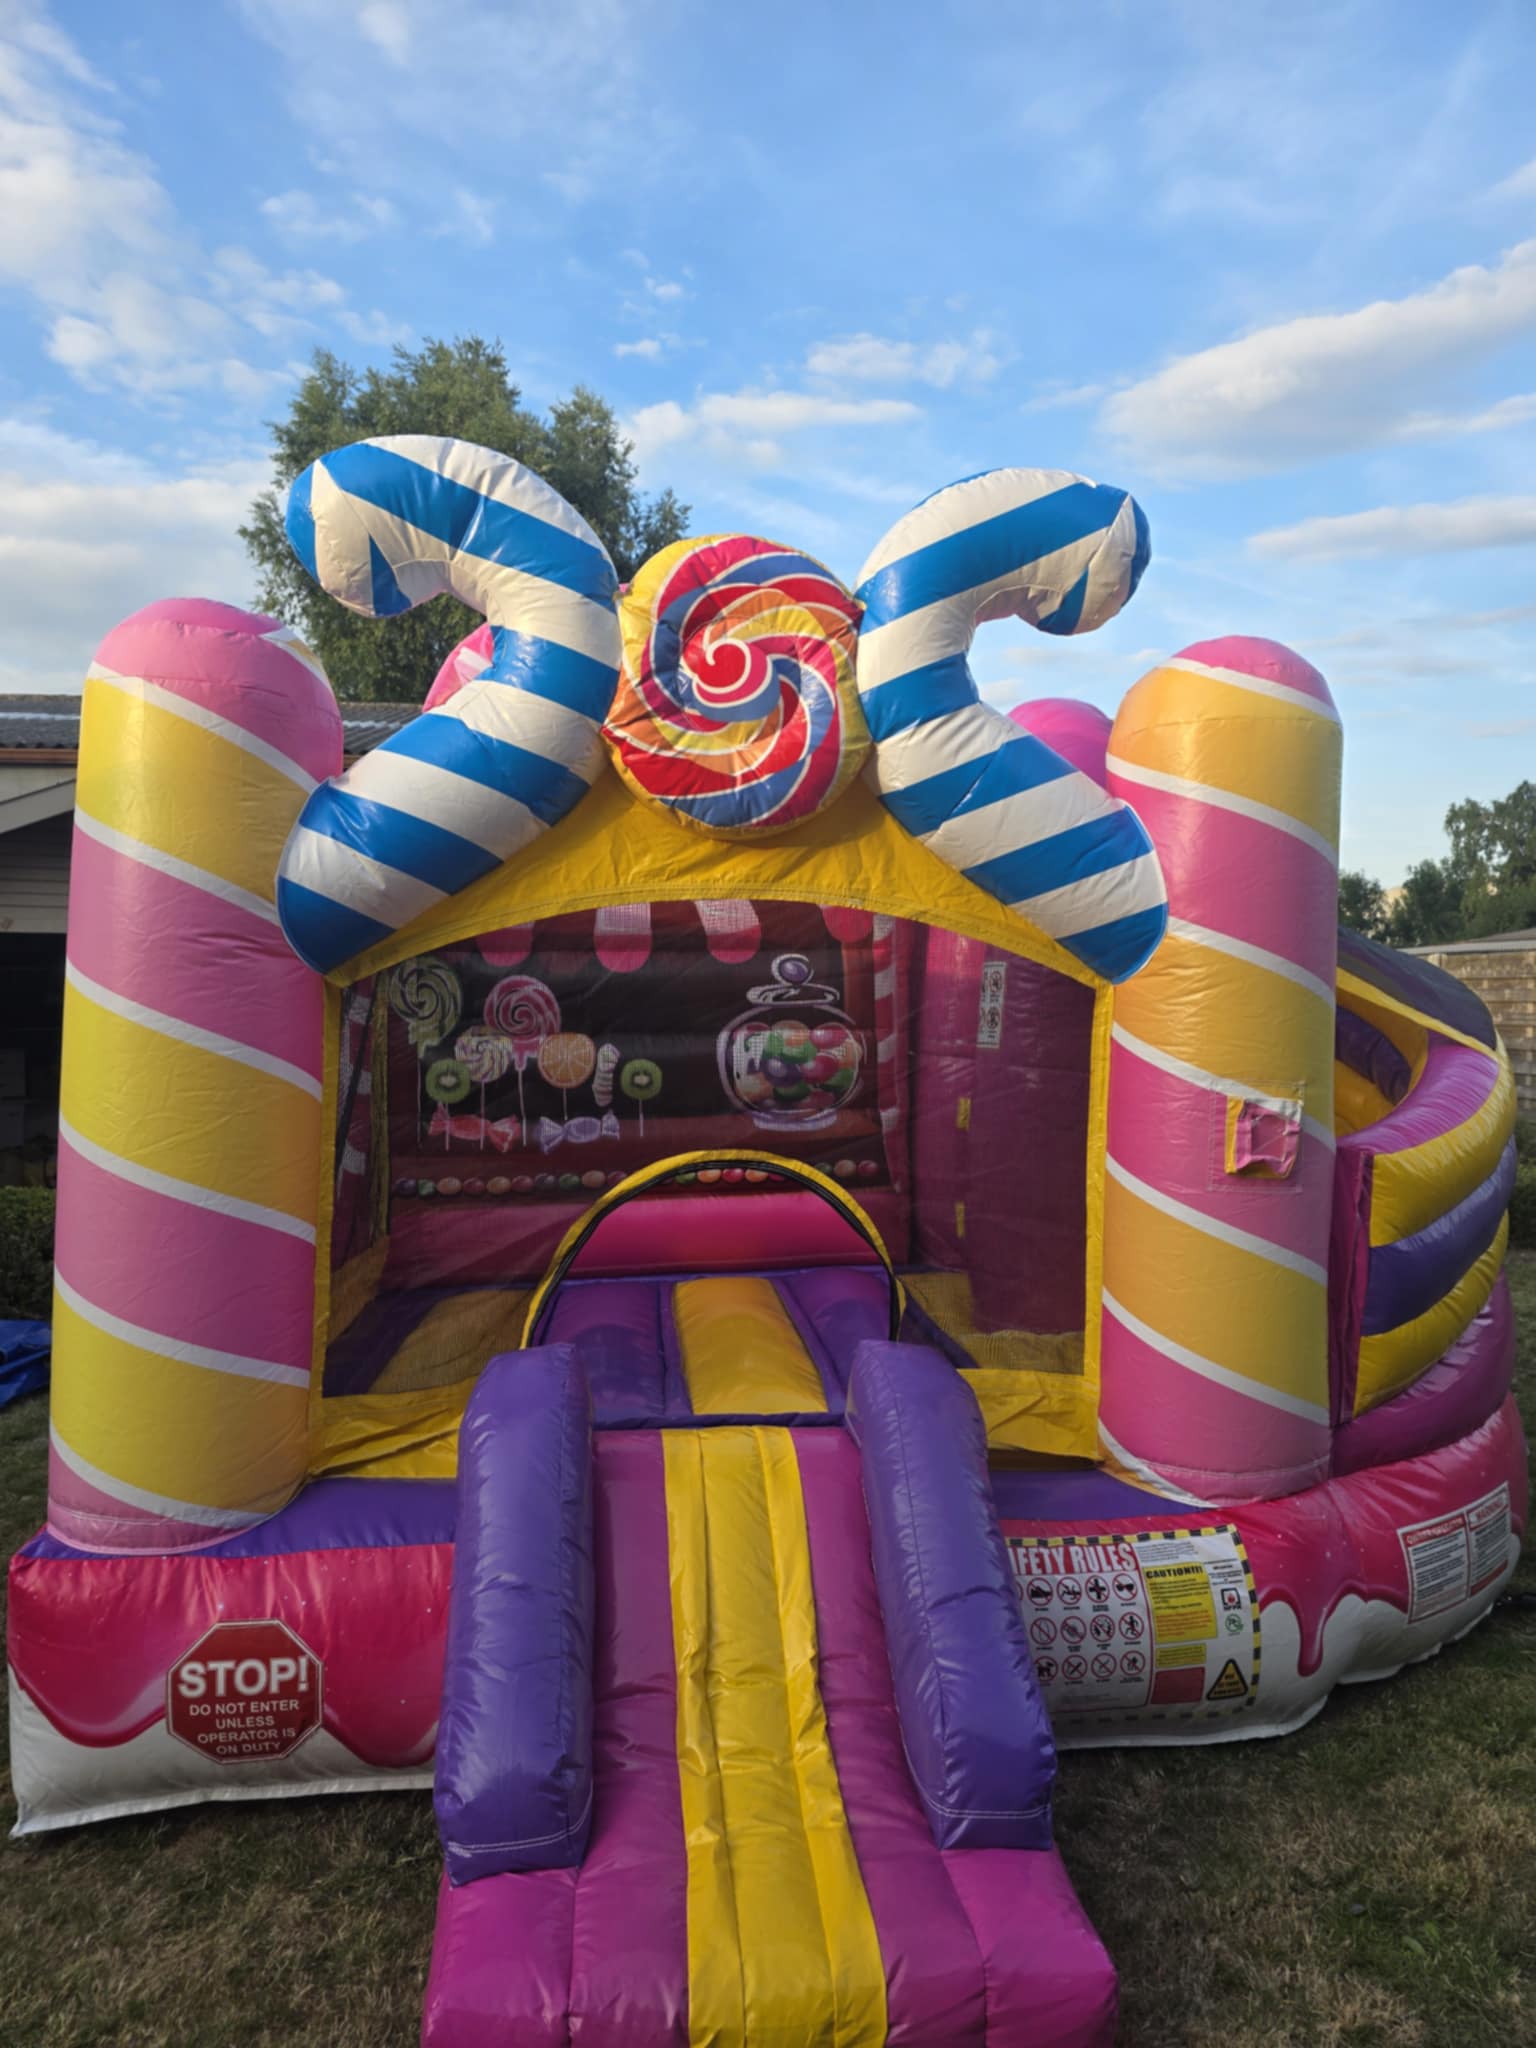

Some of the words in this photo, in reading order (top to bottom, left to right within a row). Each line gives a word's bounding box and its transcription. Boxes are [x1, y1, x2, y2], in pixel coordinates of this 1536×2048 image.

[1008, 1545, 1066, 1574] FETY
[1069, 1543, 1137, 1573] RULES
[178, 1656, 309, 1698] STOP!
[189, 1704, 211, 1716] DO
[215, 1702, 246, 1715] NOT
[250, 1700, 299, 1713] ENTER
[215, 1715, 275, 1729] UNLESS
[197, 1730, 279, 1744] OPERATOR
[282, 1728, 296, 1738] IS
[216, 1744, 238, 1755] ON
[242, 1742, 281, 1753] DUTY
